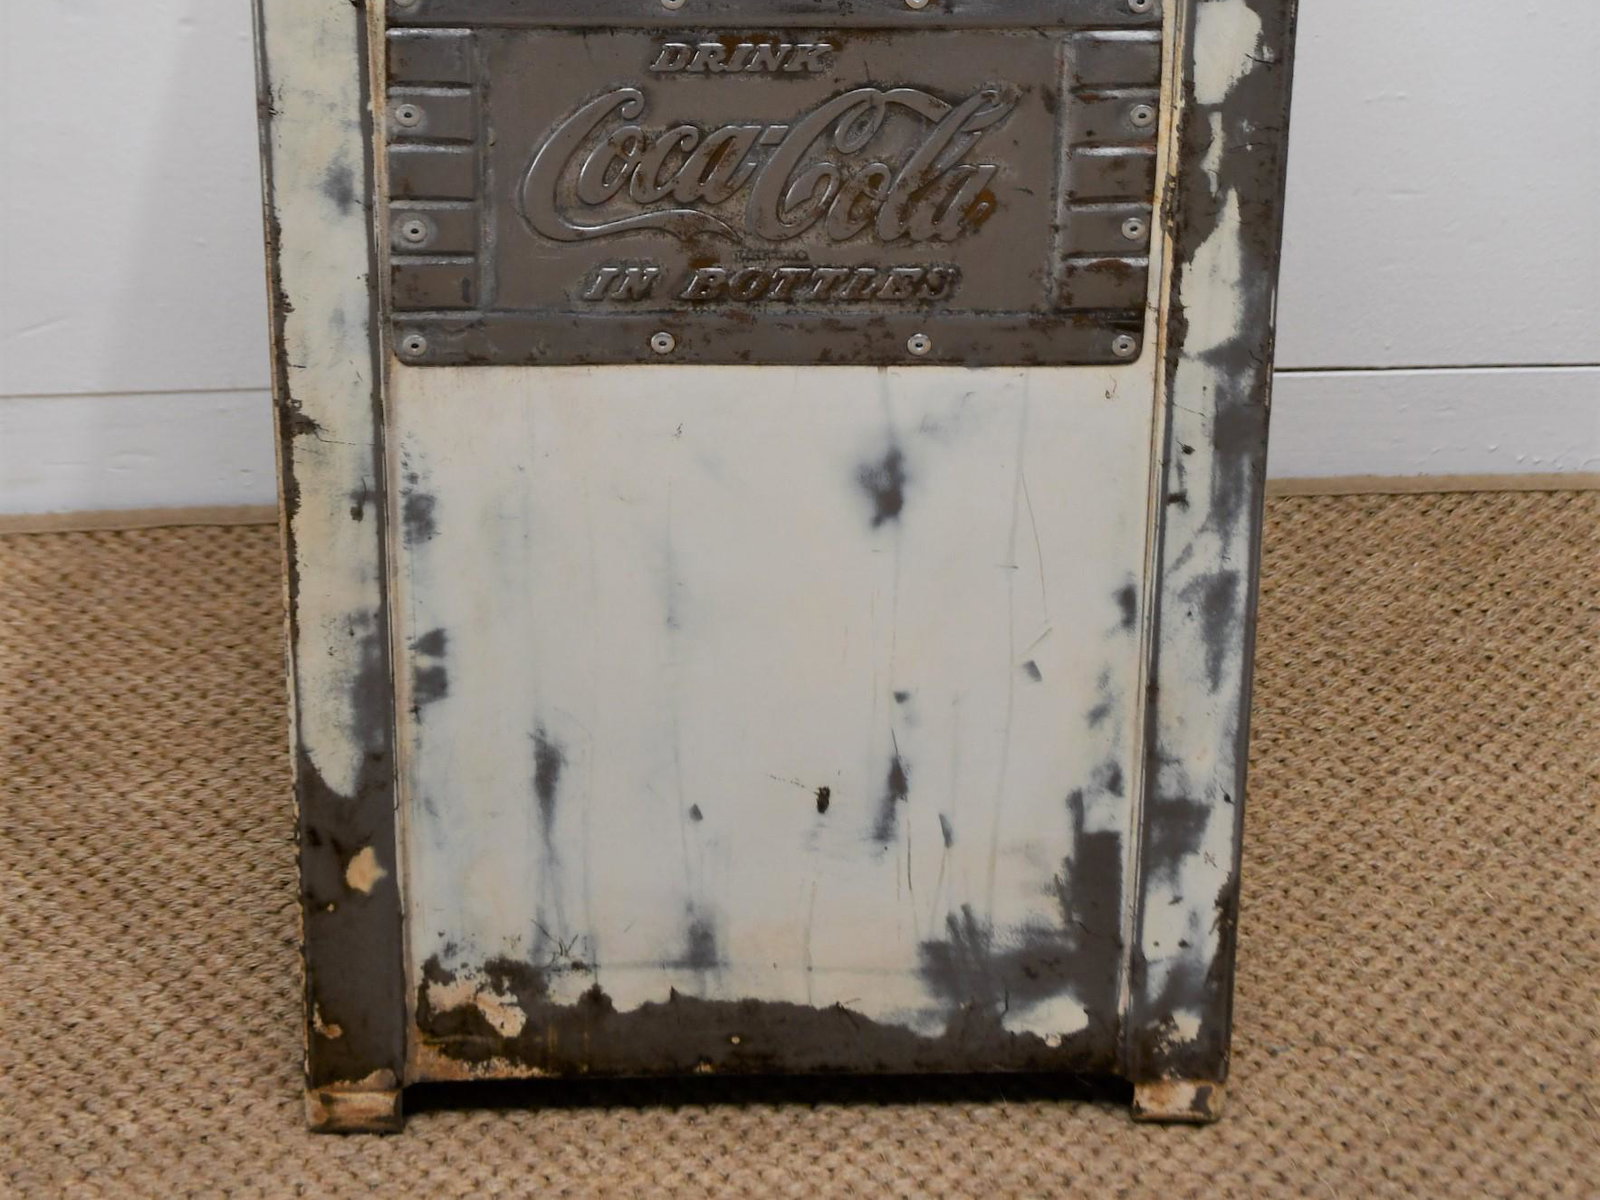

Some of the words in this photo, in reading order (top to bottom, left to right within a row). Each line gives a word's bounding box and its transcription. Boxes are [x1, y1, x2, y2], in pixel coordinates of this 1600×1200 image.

[649, 41, 831, 73] DRINK
[522, 86, 1021, 243] Coca-Cola
[583, 266, 660, 301] IN
[680, 266, 962, 301] BOTTLES
